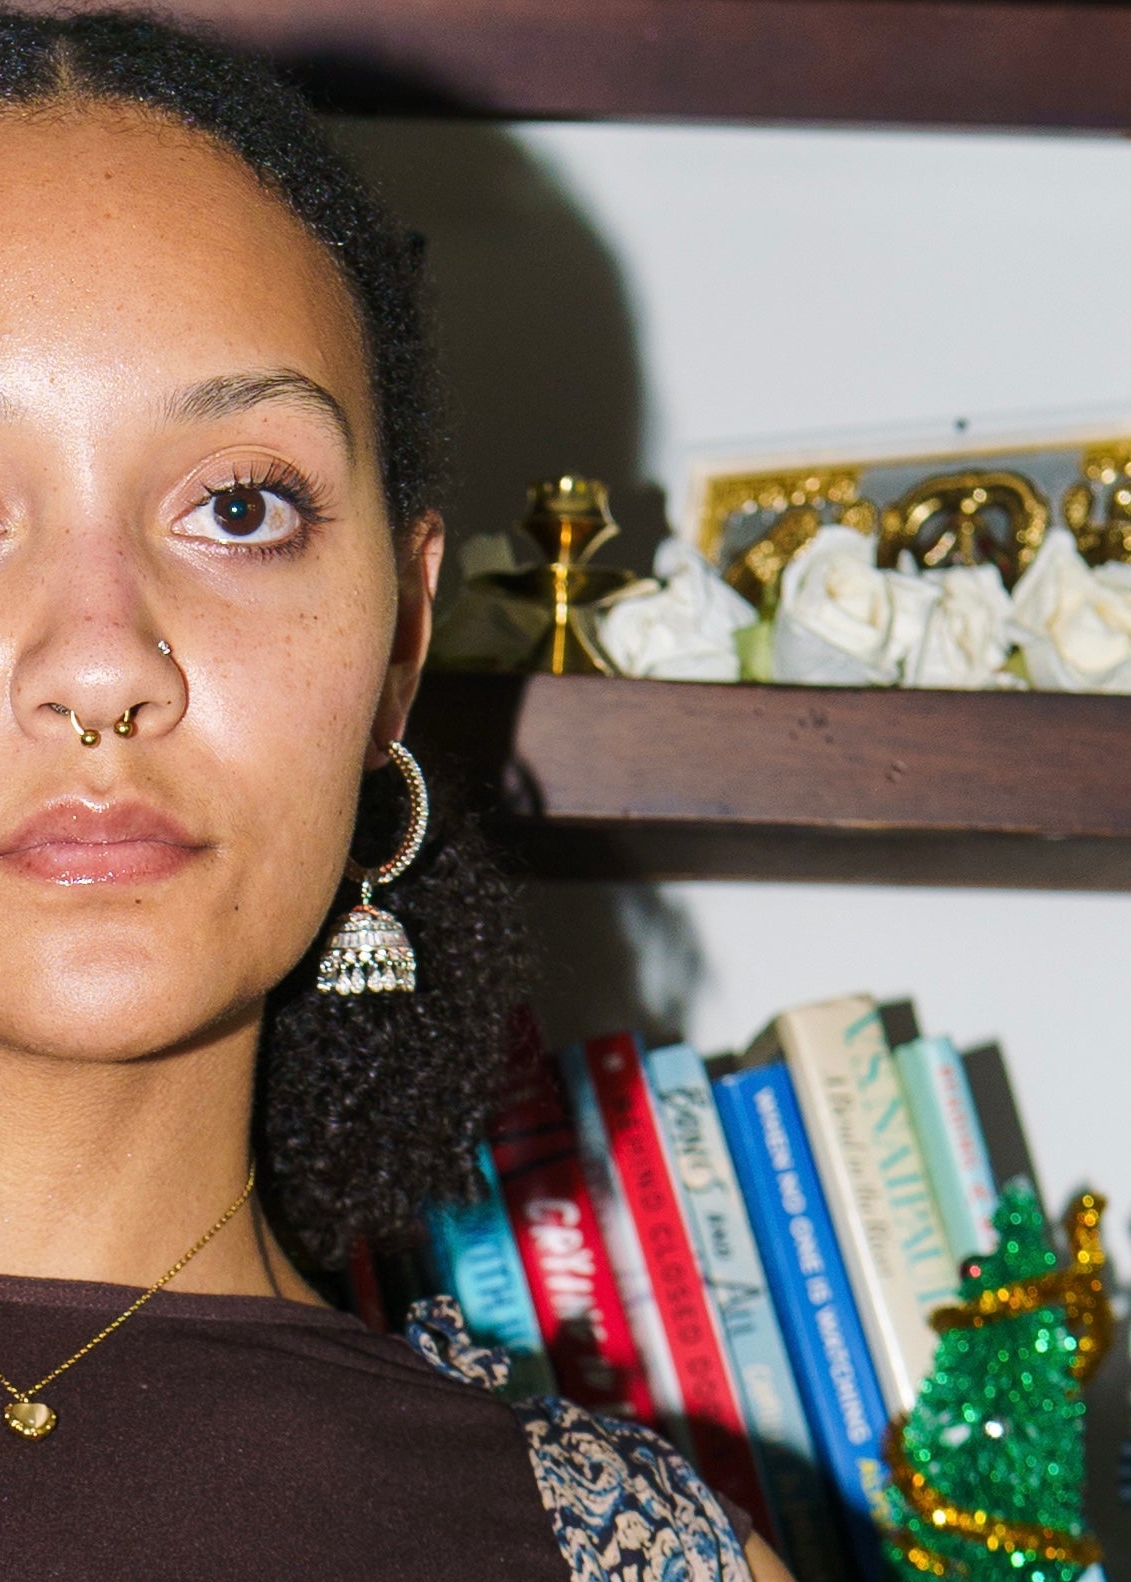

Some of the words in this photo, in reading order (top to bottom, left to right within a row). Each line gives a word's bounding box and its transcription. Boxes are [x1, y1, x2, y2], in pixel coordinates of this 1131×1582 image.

[753, 1085, 794, 1171] WHEN
[611, 1093, 666, 1213] BEHIND
[648, 1221, 702, 1346] CLOSED
[776, 1170, 807, 1216] NO
[788, 1215, 825, 1276] ONE
[805, 1275, 832, 1307] IS
[815, 1304, 872, 1446] WATCHING
